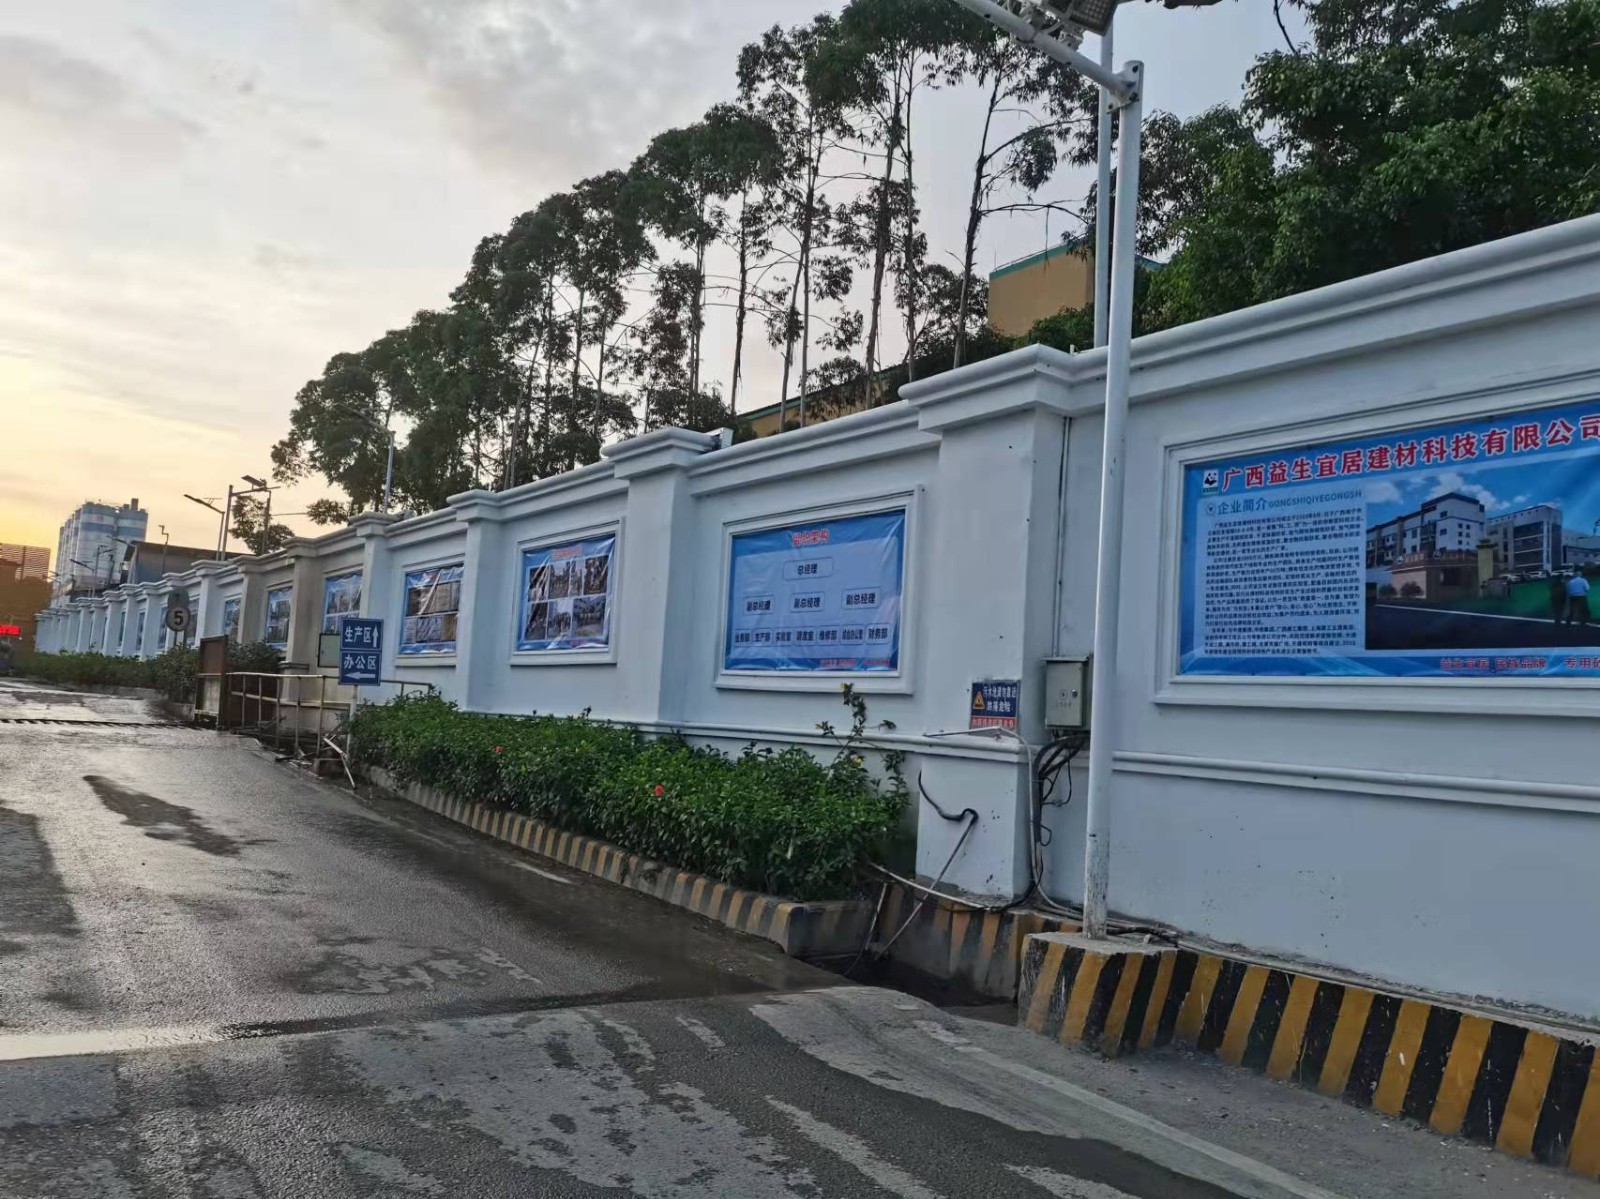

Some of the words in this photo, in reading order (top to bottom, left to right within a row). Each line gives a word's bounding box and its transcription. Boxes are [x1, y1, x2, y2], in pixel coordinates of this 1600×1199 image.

[1221, 414, 1600, 491] 广西益生宜居建材科技有限公司
[1217, 497, 1268, 515] 企业简介
[797, 563, 818, 575] 总经理
[846, 592, 876, 605] 副总经理
[174, 610, 184, 626] 5
[344, 625, 372, 643] 生产区
[343, 653, 377, 670] 办公区
